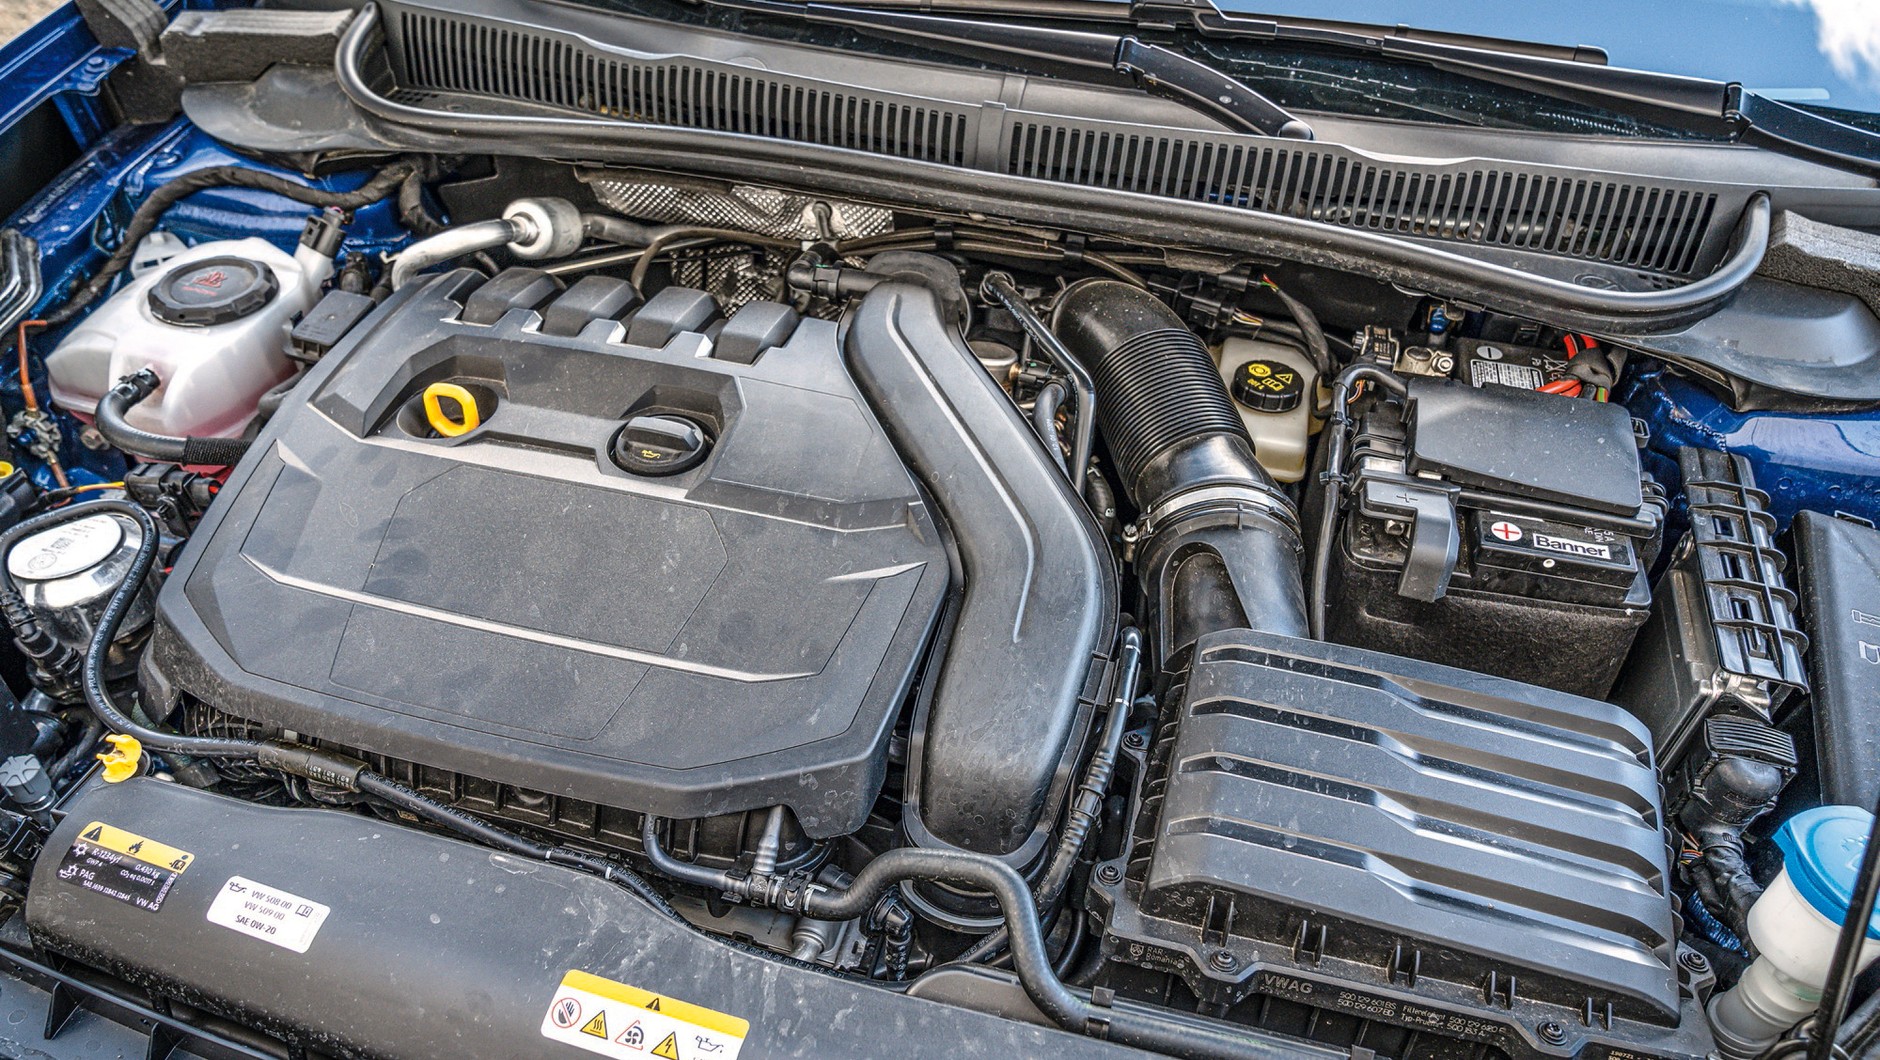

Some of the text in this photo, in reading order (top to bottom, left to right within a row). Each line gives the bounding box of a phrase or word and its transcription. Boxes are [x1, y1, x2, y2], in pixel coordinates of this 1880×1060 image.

[1536, 536, 1606, 556] Banner
[92, 848, 122, 864] R-1234yf
[79, 869, 96, 880] PAG
[151, 868, 161, 880] kg
[136, 897, 159, 911] VW AG
[252, 890, 292, 910] VW 508 00
[244, 901, 286, 921] VW 509 00
[235, 914, 277, 935] SAE 0W-20
